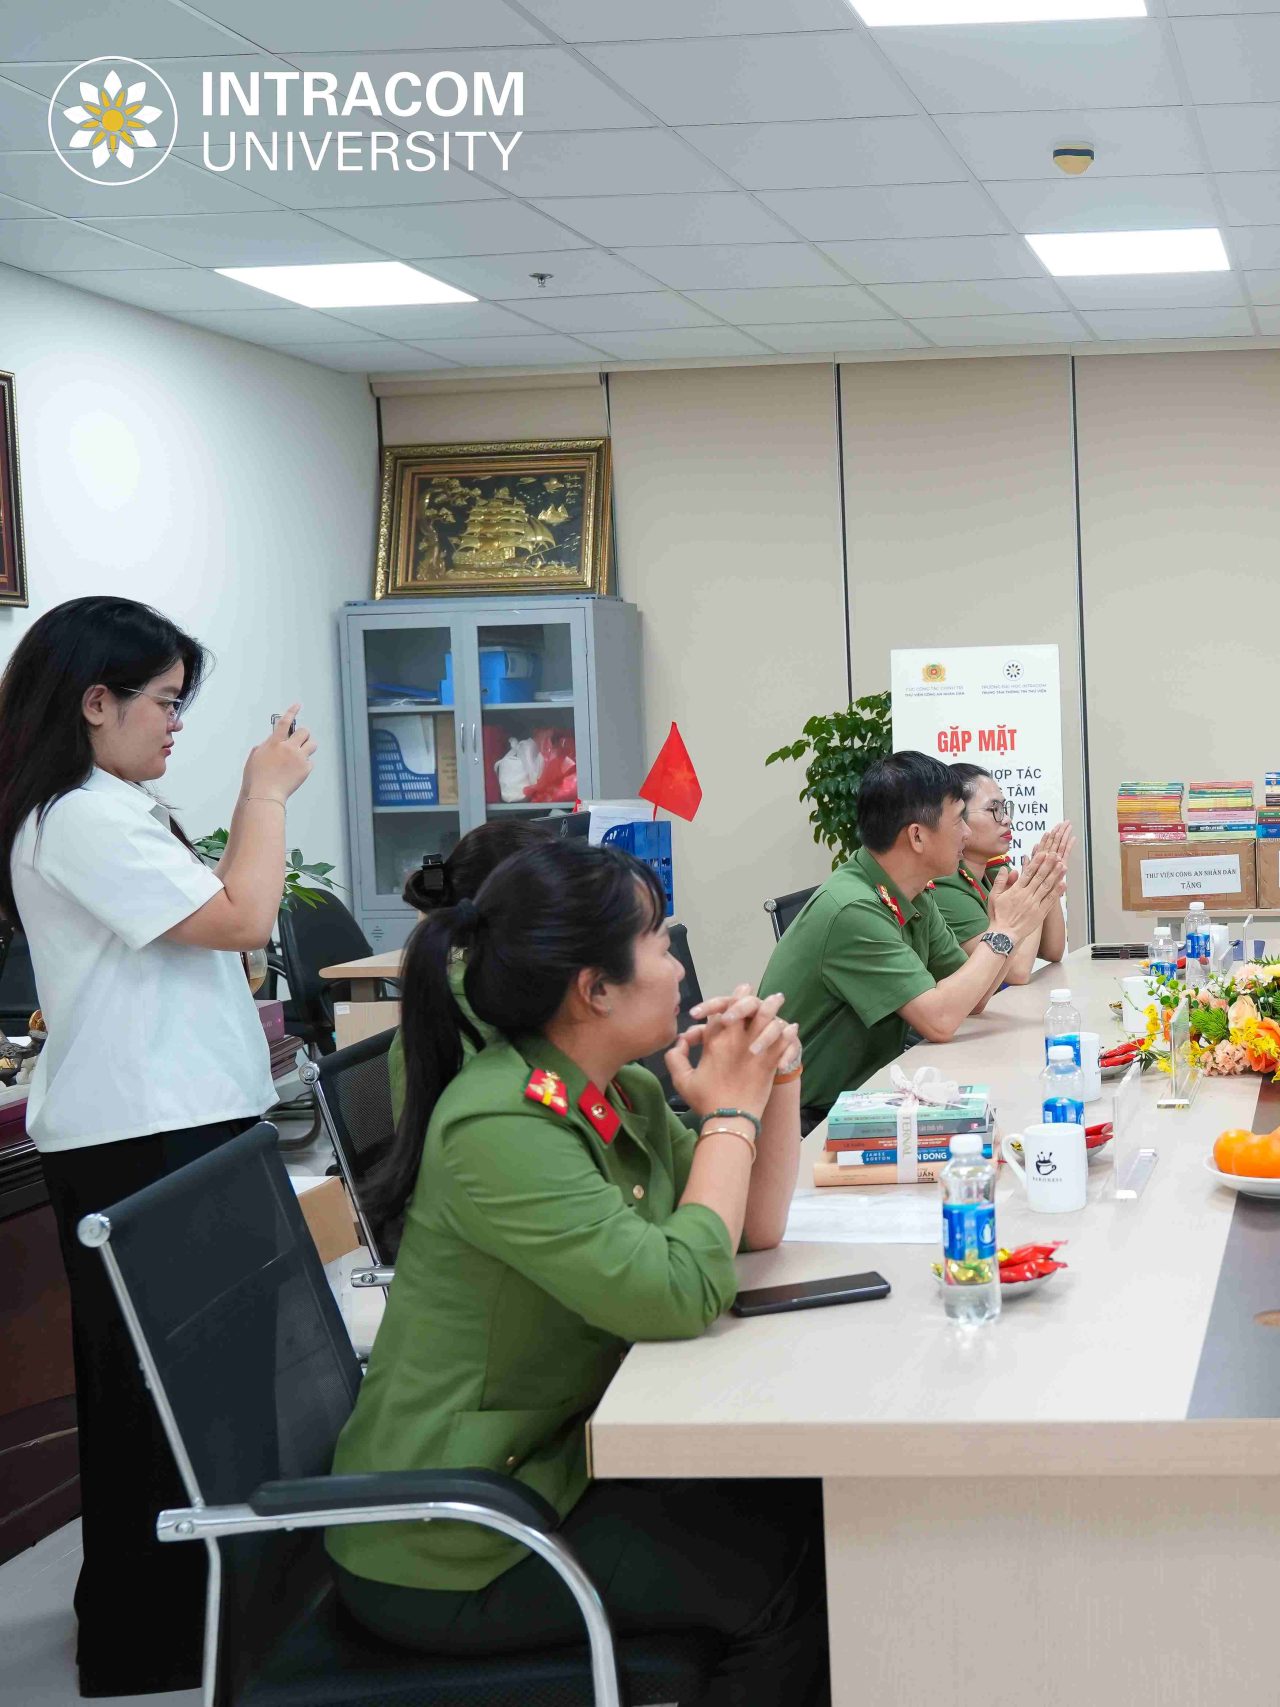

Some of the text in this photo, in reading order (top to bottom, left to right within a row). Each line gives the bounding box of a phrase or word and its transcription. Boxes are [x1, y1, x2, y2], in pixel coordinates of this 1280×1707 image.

[938, 725, 1017, 756] GẶP MẶT
[1016, 766, 1042, 779] TÁC
[1007, 784, 1035, 797] TÂM
[1018, 801, 1048, 815] VIỆN
[1009, 820, 1046, 831] ACOM
[1180, 881, 1202, 890] TẶNG
